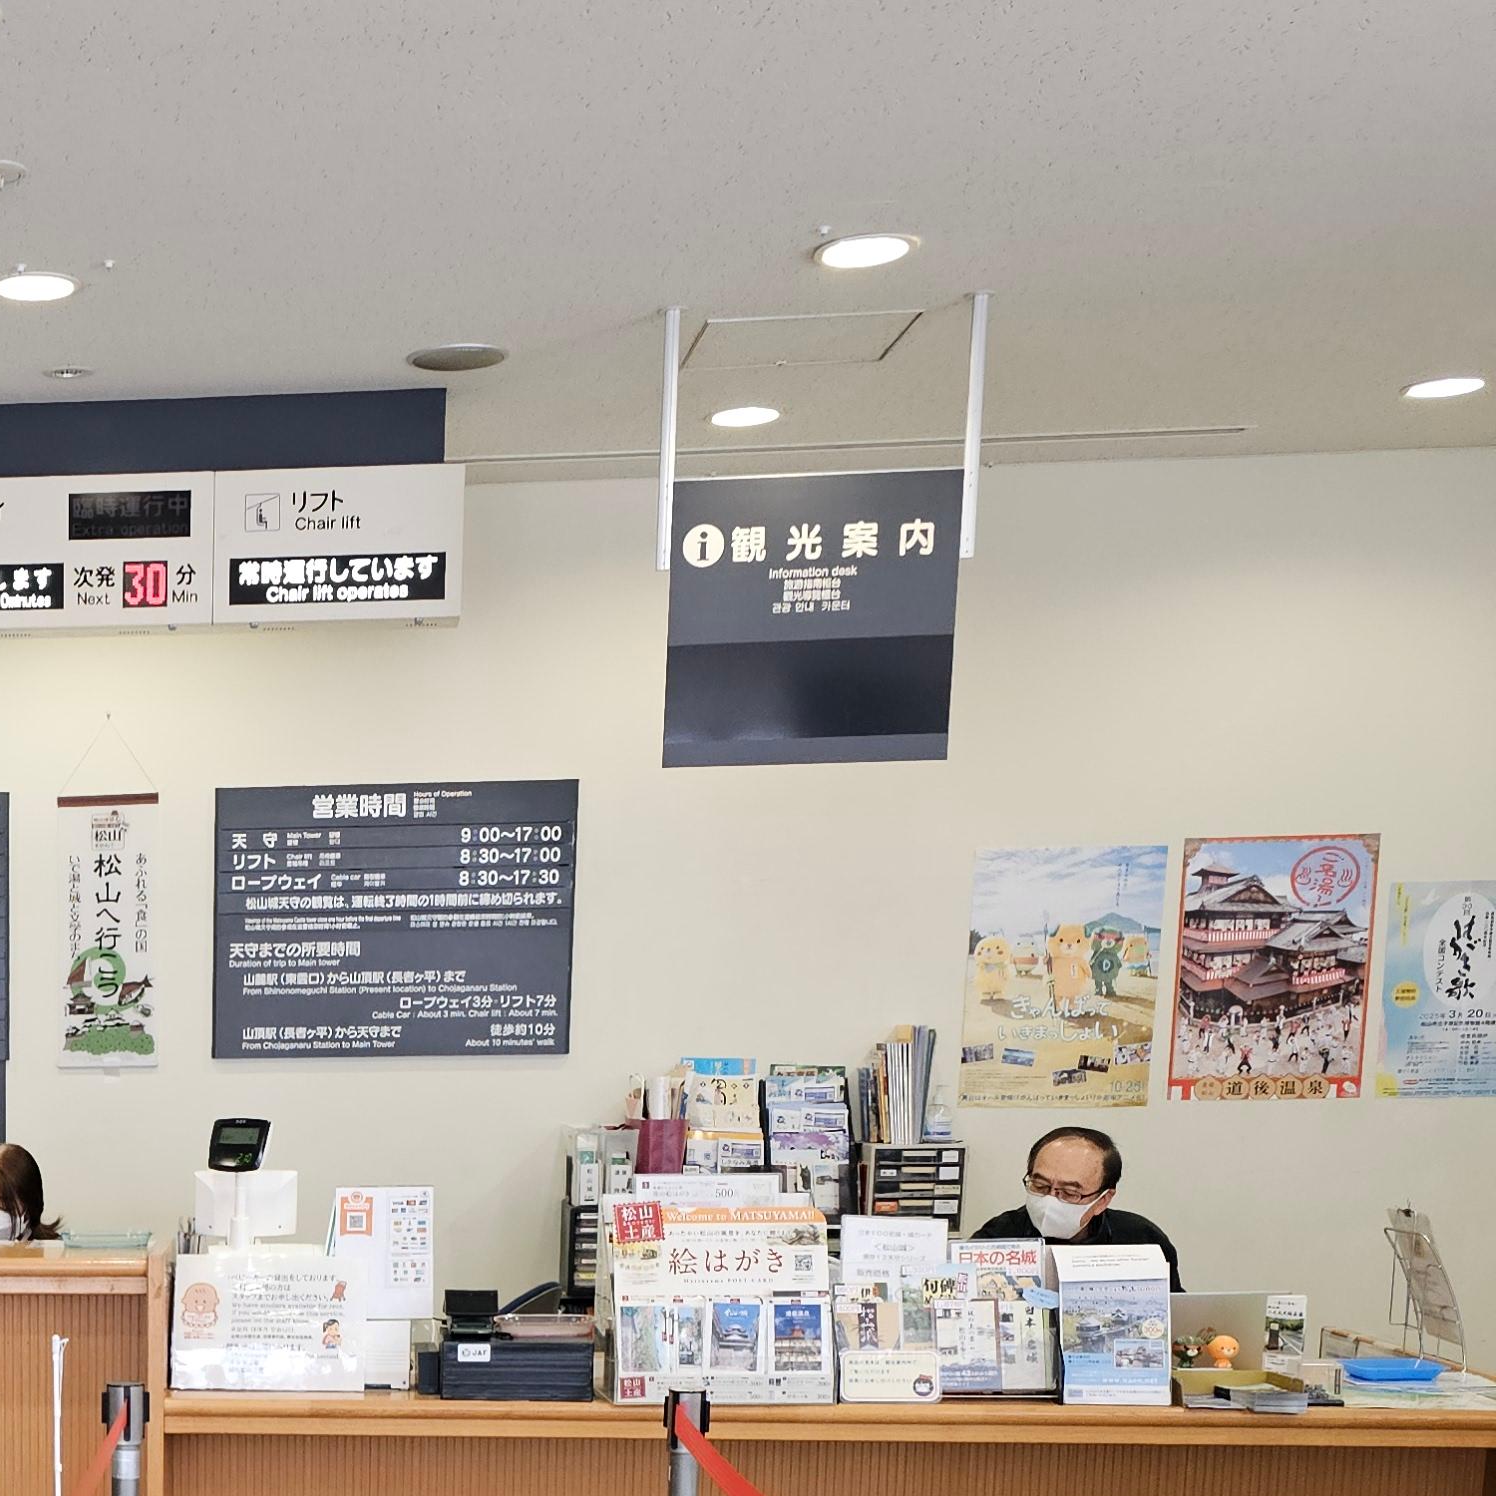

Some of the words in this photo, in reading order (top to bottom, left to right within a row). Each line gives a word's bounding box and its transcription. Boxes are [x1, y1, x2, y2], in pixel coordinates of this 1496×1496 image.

[291, 490, 343, 513] リフト
[120, 520, 188, 536] operation
[295, 516, 338, 531] Chair
[341, 515, 361, 530] lift
[731, 518, 936, 563] 観光案内
[238, 554, 439, 586] 常時運行しています
[768, 567, 829, 580] Information
[831, 565, 858, 577] desk
[73, 566, 116, 588] 次発
[124, 562, 167, 606] 30
[176, 563, 197, 586] 分
[77, 591, 111, 606] Next
[172, 589, 199, 604] Min
[266, 585, 309, 604] Chair
[312, 584, 335, 600] lift
[337, 583, 409, 602] operates
[312, 793, 407, 819] 営業時間
[94, 829, 122, 842] 松山
[461, 826, 562, 843] 9:00～17:00
[232, 853, 276, 870] リフト
[460, 847, 561, 864] 8:30～17:00
[231, 874, 322, 891] ロープウェイ
[459, 869, 560, 886] 8:30～17:30
[93, 853, 122, 998] 松山へ行こう
[229, 941, 361, 958] 天守までの所要時間
[229, 959, 261, 968] Duration
[263, 959, 272, 967] of
[273, 959, 287, 968] trip
[298, 959, 317, 967] Main
[319, 959, 340, 967] tower
[243, 987, 262, 995] From
[428, 985, 436, 993] to
[489, 983, 517, 992] Station
[417, 1010, 441, 1019] About
[468, 1010, 490, 1018] Chair
[508, 1009, 534, 1018] About
[490, 1023, 556, 1037] 徒歩約10分
[998, 1021, 1119, 1042] いきまっしょい
[313, 1041, 340, 1050] Station
[342, 1041, 350, 1049] to
[465, 1039, 490, 1048] About
[1226, 1081, 1324, 1095] 道後温泉
[715, 1188, 734, 1198] 500
[623, 1205, 653, 1220] 松山
[667, 1212, 714, 1221] Welcome
[716, 1212, 727, 1221] to
[731, 1208, 815, 1221] MATSUYAMA!!
[624, 1225, 656, 1241] 土産
[668, 1246, 784, 1275] 絵はがき
[959, 1250, 1037, 1266] 日本の名城
